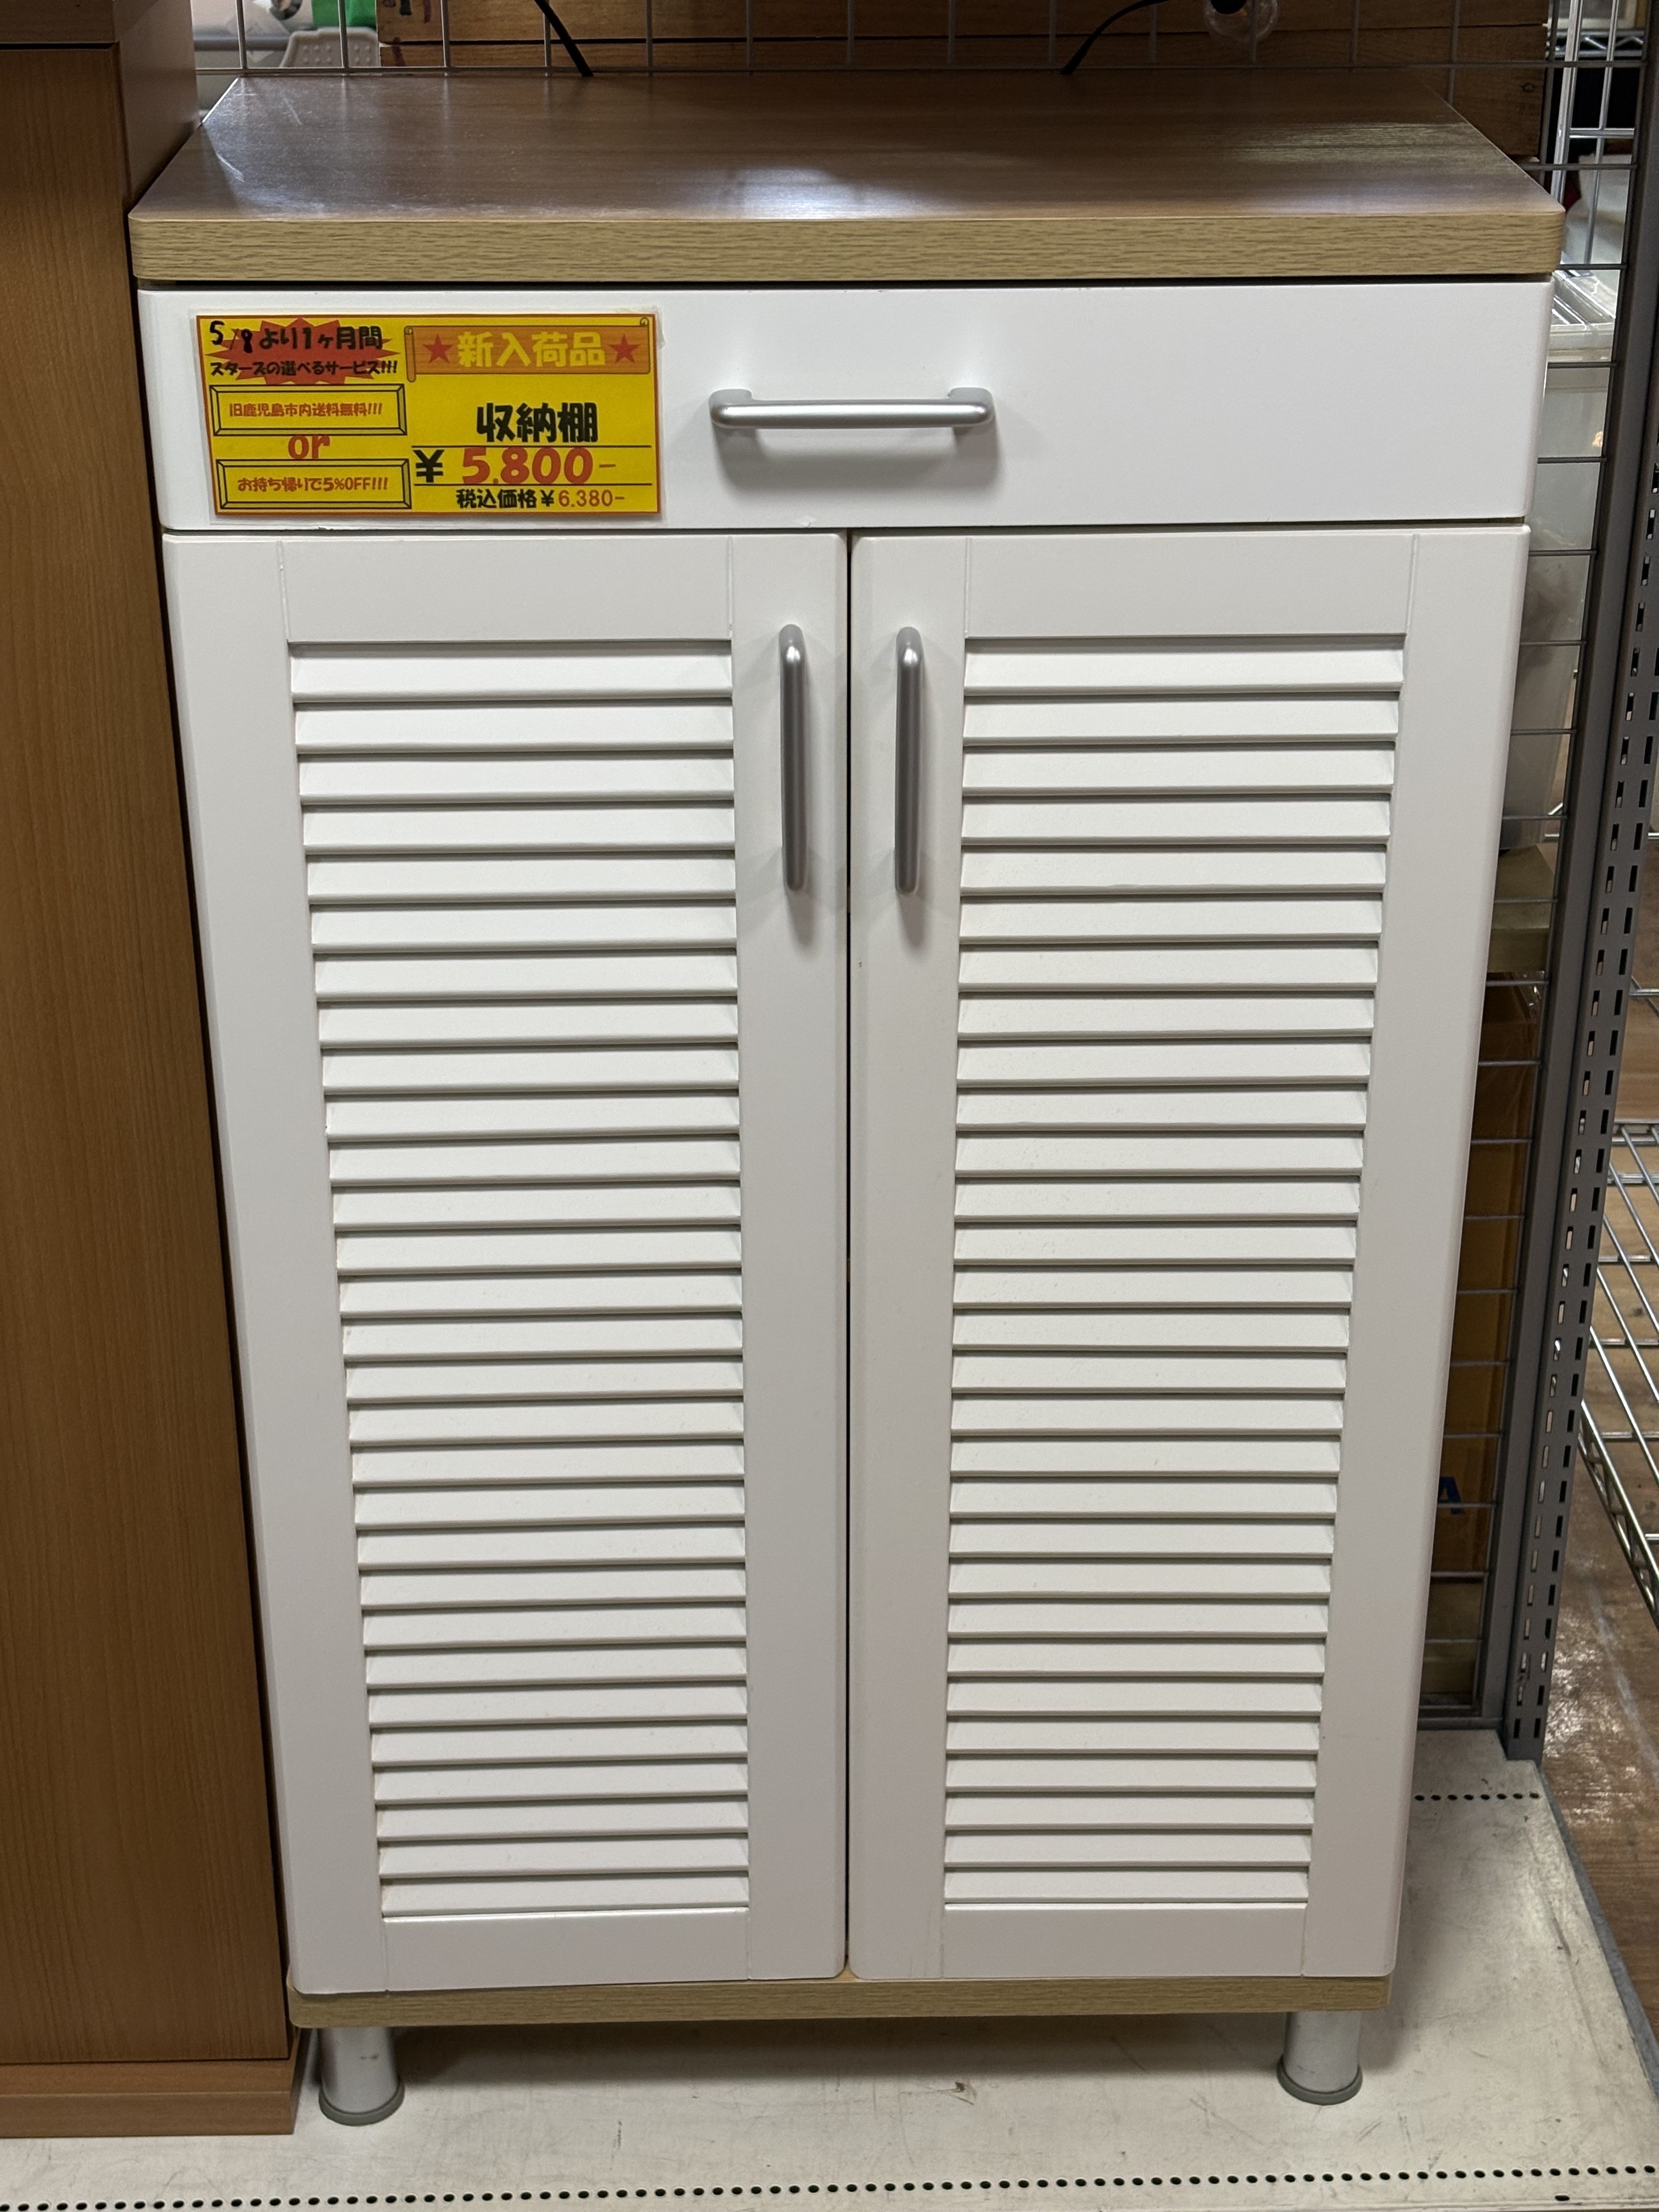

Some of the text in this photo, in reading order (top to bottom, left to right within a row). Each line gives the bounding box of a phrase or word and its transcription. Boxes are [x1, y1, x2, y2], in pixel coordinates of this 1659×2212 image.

[458, 331, 606, 368] 新入荷品
[476, 402, 599, 443] 収納棚
[288, 435, 330, 460] or
